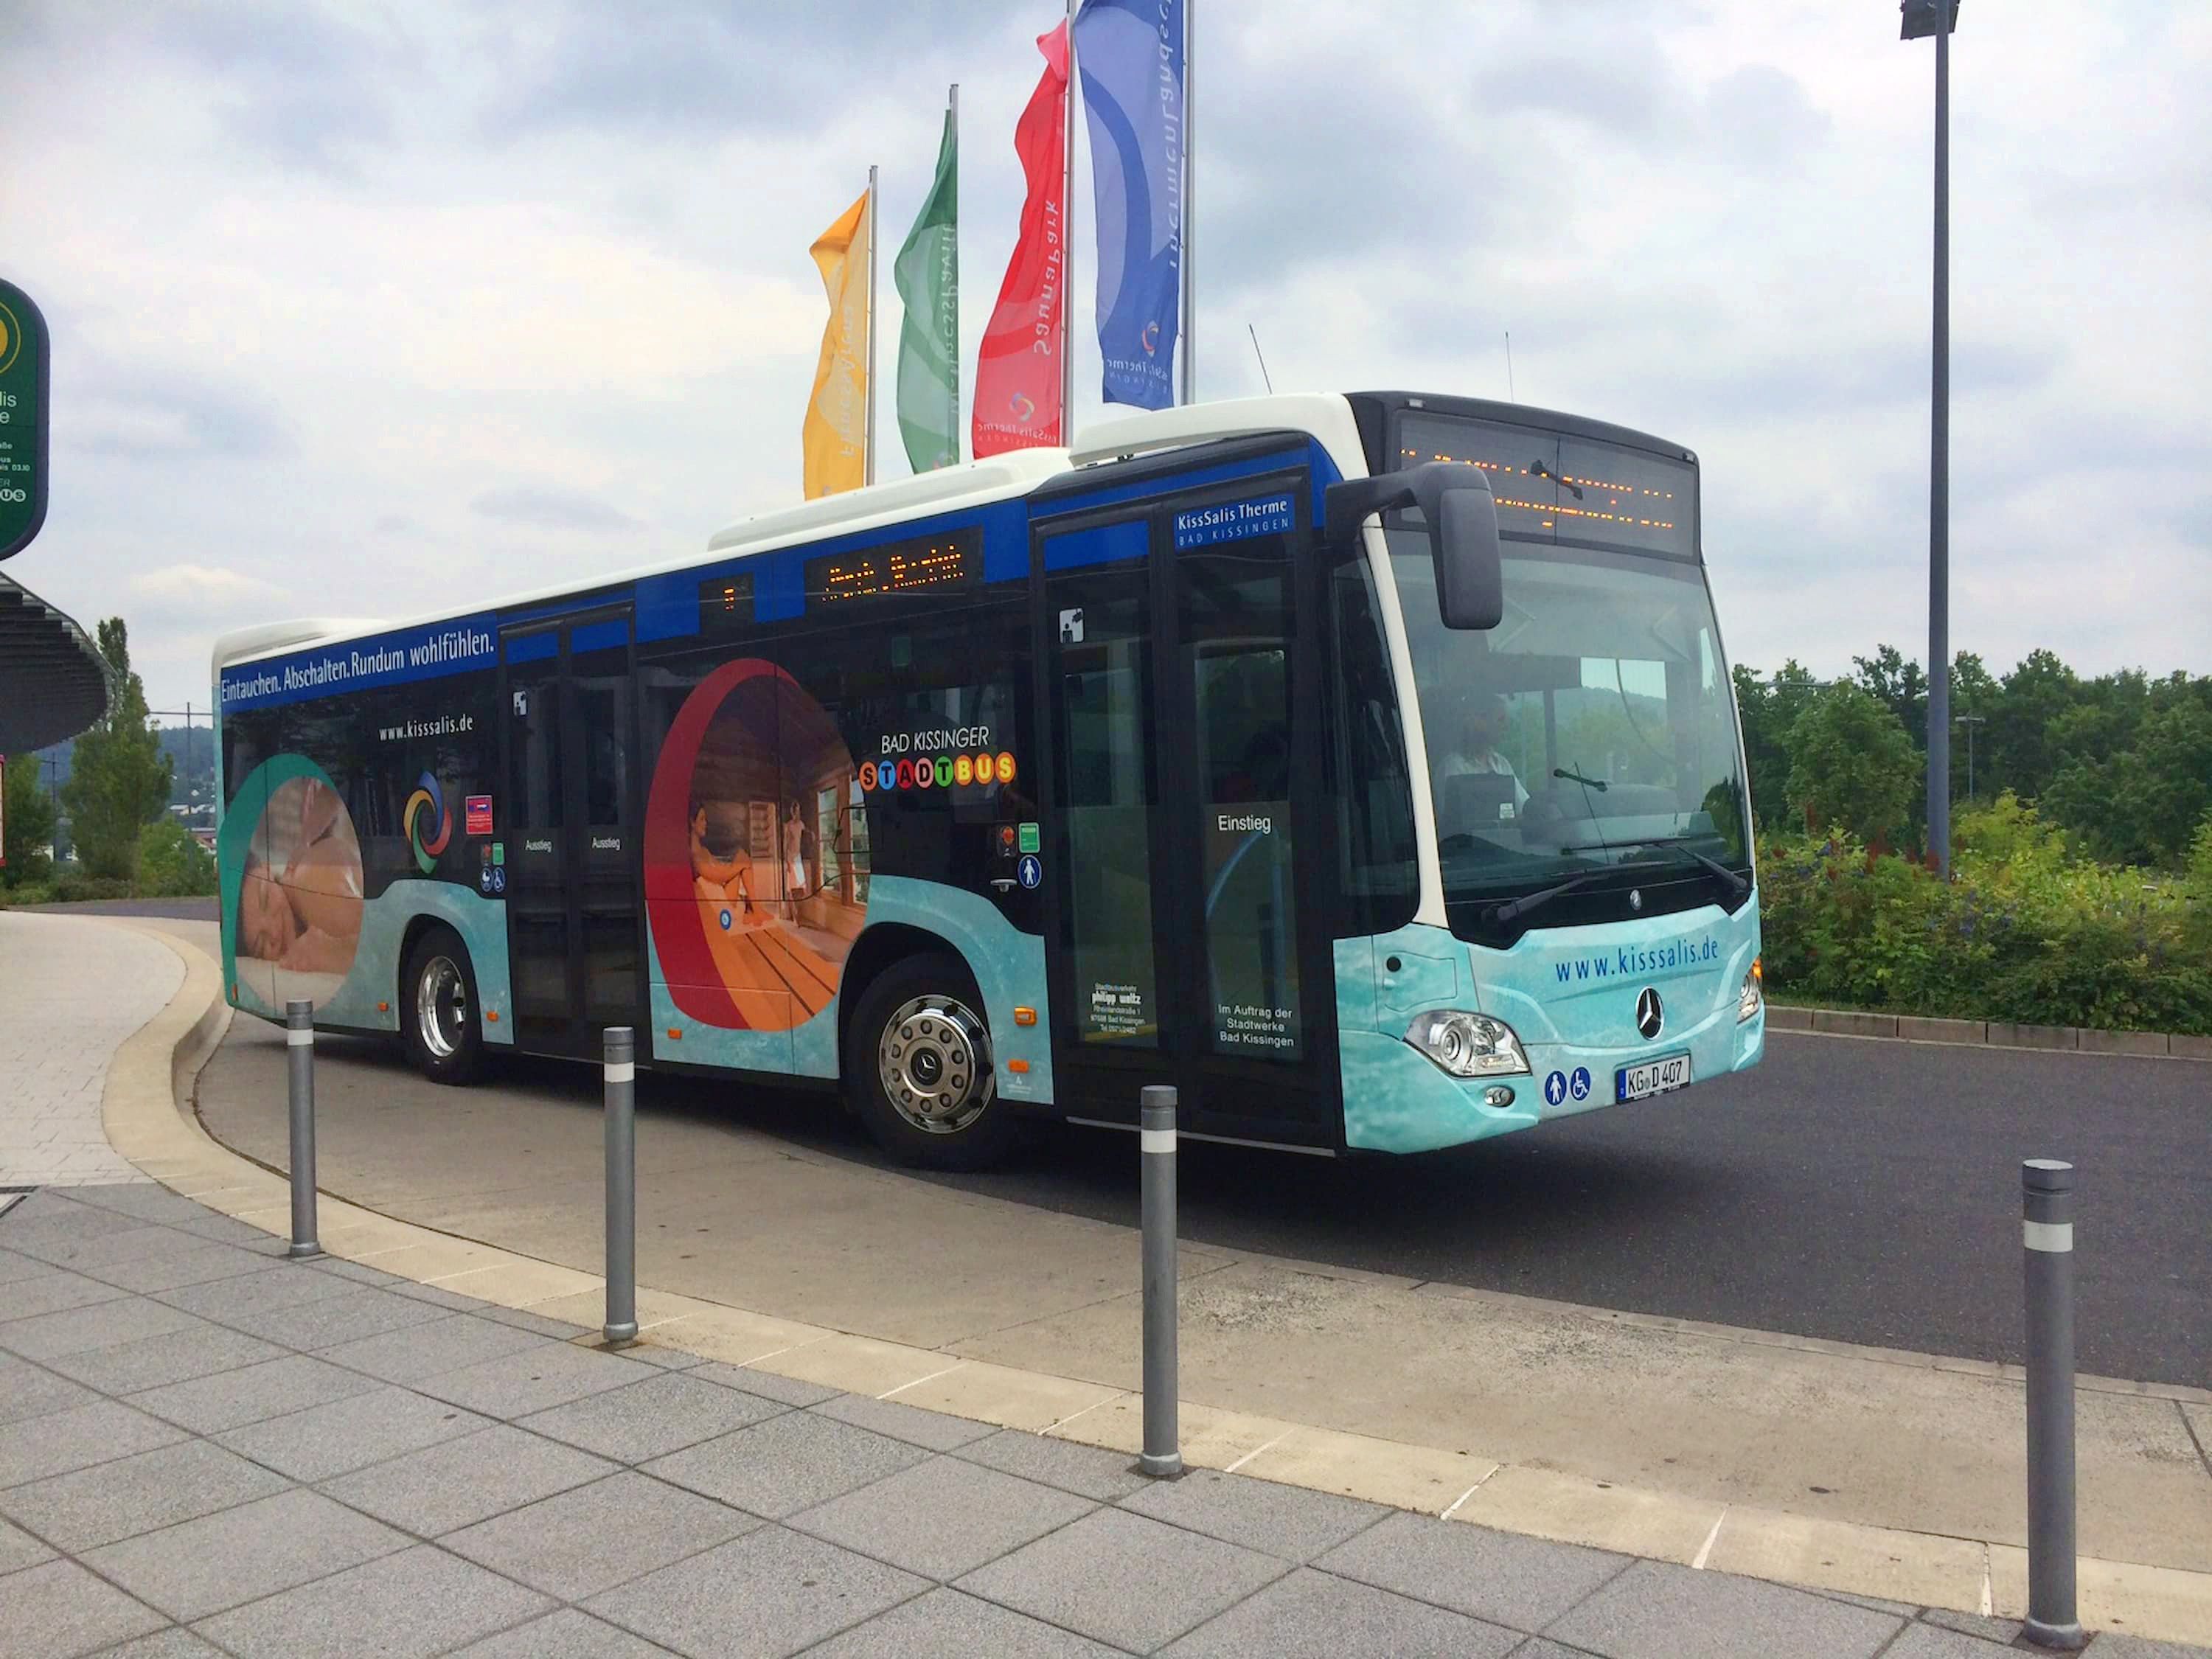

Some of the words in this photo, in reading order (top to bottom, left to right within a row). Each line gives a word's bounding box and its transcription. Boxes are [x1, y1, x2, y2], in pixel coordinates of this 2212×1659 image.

[1178, 508, 1236, 530] KissSalis
[1238, 500, 1287, 519] Therme
[1179, 532, 1203, 546] BAD
[1212, 518, 1289, 540] KISSINGEN
[221, 672, 282, 701] Eintauchen.
[283, 659, 350, 690] Abschalten.
[351, 647, 404, 677] Rundum
[379, 713, 473, 741] www.kisssalis.de
[881, 734, 910, 754] BAD
[914, 726, 990, 751] KISSINGER
[861, 754, 1013, 787] STADTBUS
[1218, 814, 1271, 835] Einstieg
[1556, 935, 1718, 982] www.kisssalis.de
[1218, 1004, 1231, 1015] Im
[1234, 1005, 1272, 1020] Auftrag
[1275, 1008, 1293, 1018] der
[1227, 1018, 1285, 1032] Stadtwerke
[1220, 1031, 1239, 1042] Bad
[1242, 1033, 1295, 1048] Kissingen
[1628, 1071, 1644, 1093] KG
[1652, 1066, 1660, 1088] D
[1662, 1060, 1683, 1084] 407
